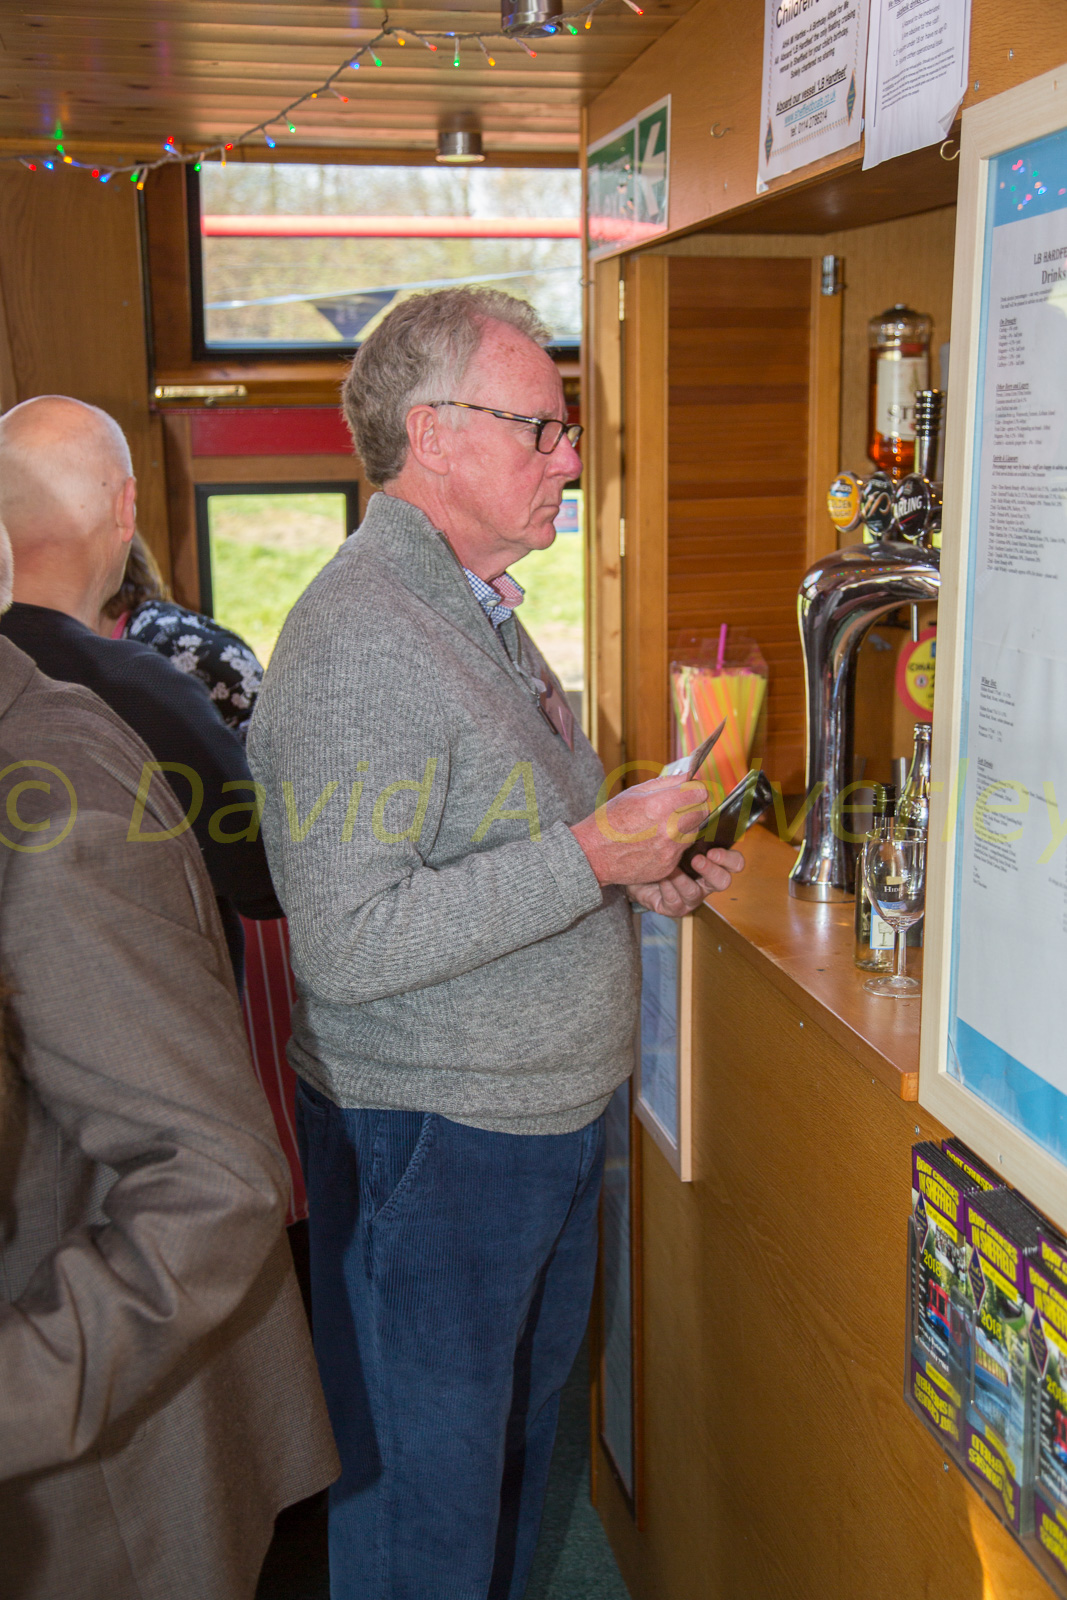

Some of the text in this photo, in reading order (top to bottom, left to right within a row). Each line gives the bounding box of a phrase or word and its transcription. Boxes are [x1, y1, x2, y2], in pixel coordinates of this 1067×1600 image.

[776, 95, 792, 112] Aboard
[793, 92, 801, 105] our
[801, 82, 816, 99] vessel
[1042, 267, 1067, 285] Drinks
[925, 1175, 957, 1223] SHEFFIELD
[932, 1169, 959, 1206] CRUISES
[979, 1230, 1017, 1283] SHEFFIELD
[986, 1223, 1018, 1265] CRUISES
[923, 1248, 942, 1277] 2018
[981, 1308, 1002, 1340] 2018
